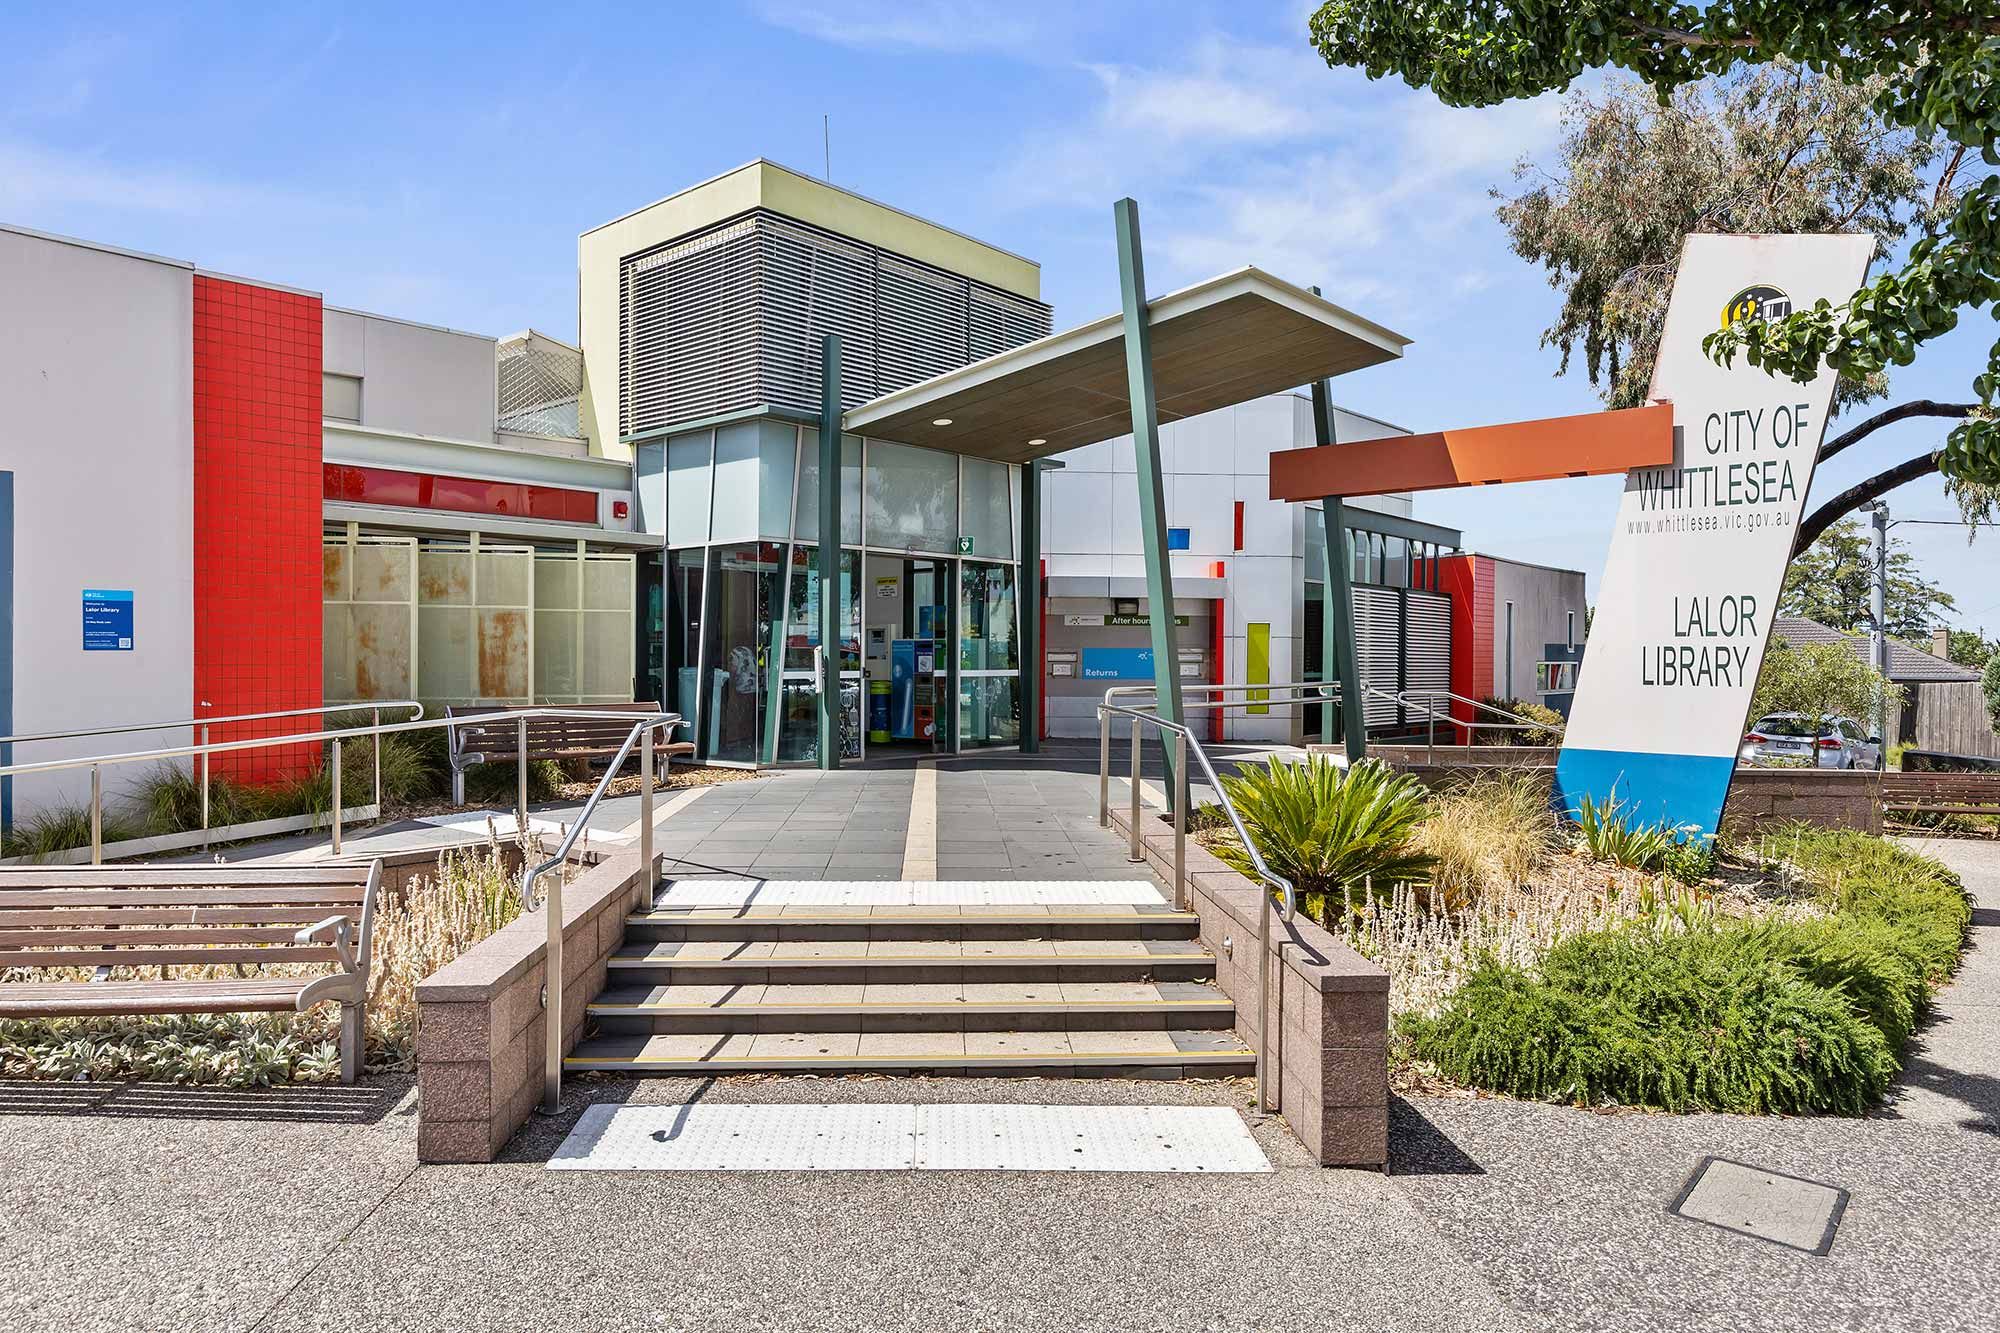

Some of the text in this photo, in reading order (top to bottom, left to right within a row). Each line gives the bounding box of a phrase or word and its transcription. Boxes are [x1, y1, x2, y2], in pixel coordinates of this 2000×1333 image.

[1704, 403, 1810, 455] CITY OF
[1637, 460, 1797, 512] WHITTLESEA
[1627, 511, 1791, 536] www.whittlesea.vic.gov.au
[1111, 617, 1131, 625] After
[1674, 594, 1758, 638] LALOR
[1085, 668, 1119, 677] Returns
[1642, 644, 1751, 688] LIBRARY
